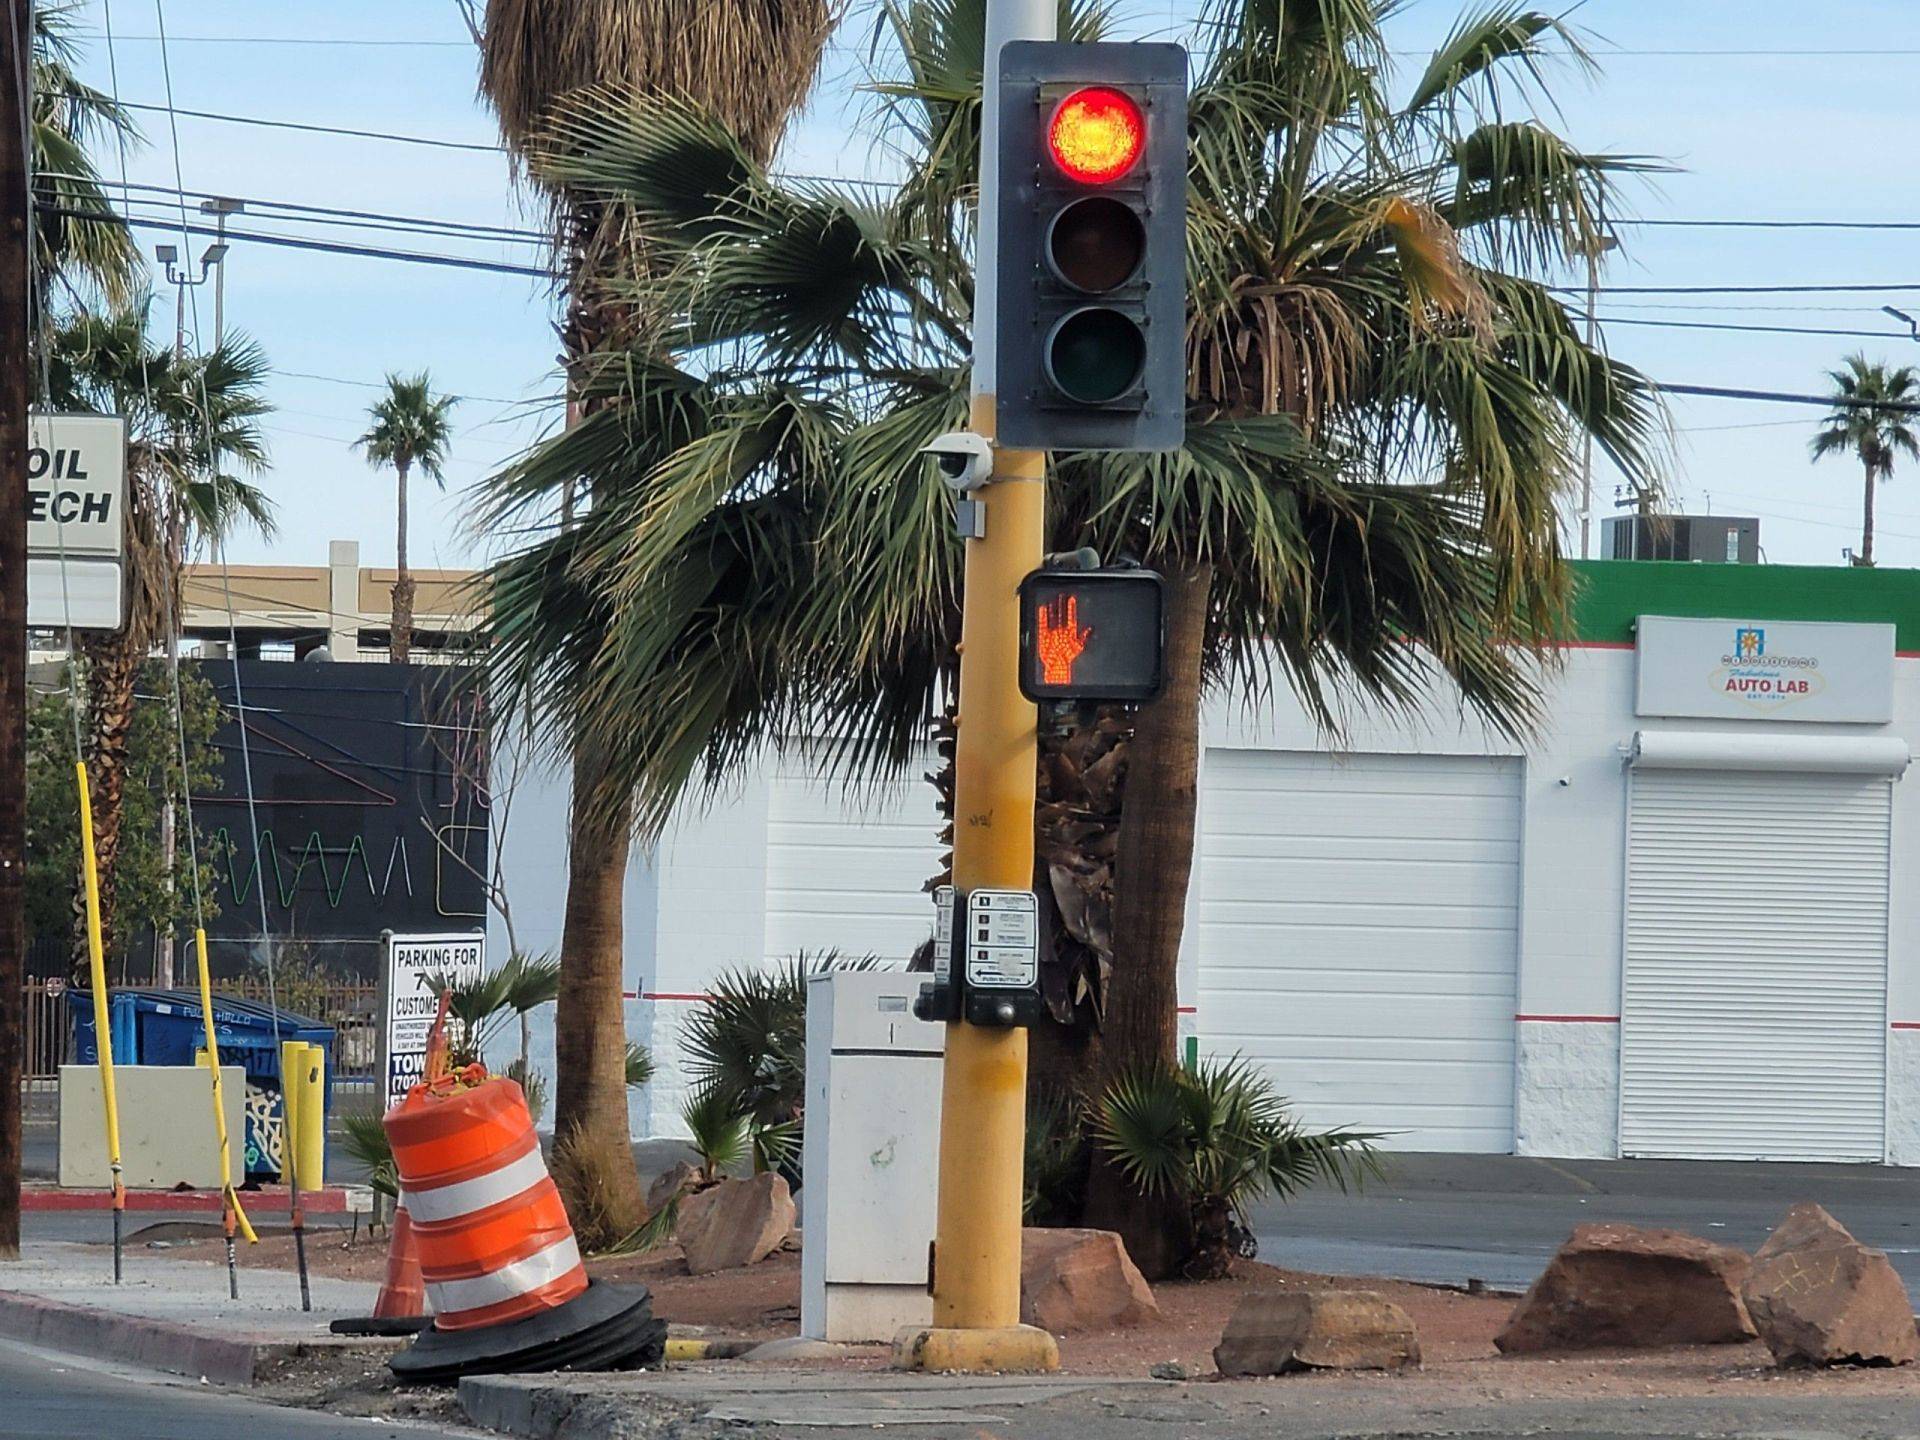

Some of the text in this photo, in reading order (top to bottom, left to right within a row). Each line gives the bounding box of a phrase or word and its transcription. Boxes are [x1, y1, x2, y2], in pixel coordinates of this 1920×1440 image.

[27, 447, 88, 480] OIL
[1725, 678, 1809, 693] AUTO LAB
[398, 948, 477, 967] PARKING FOR
